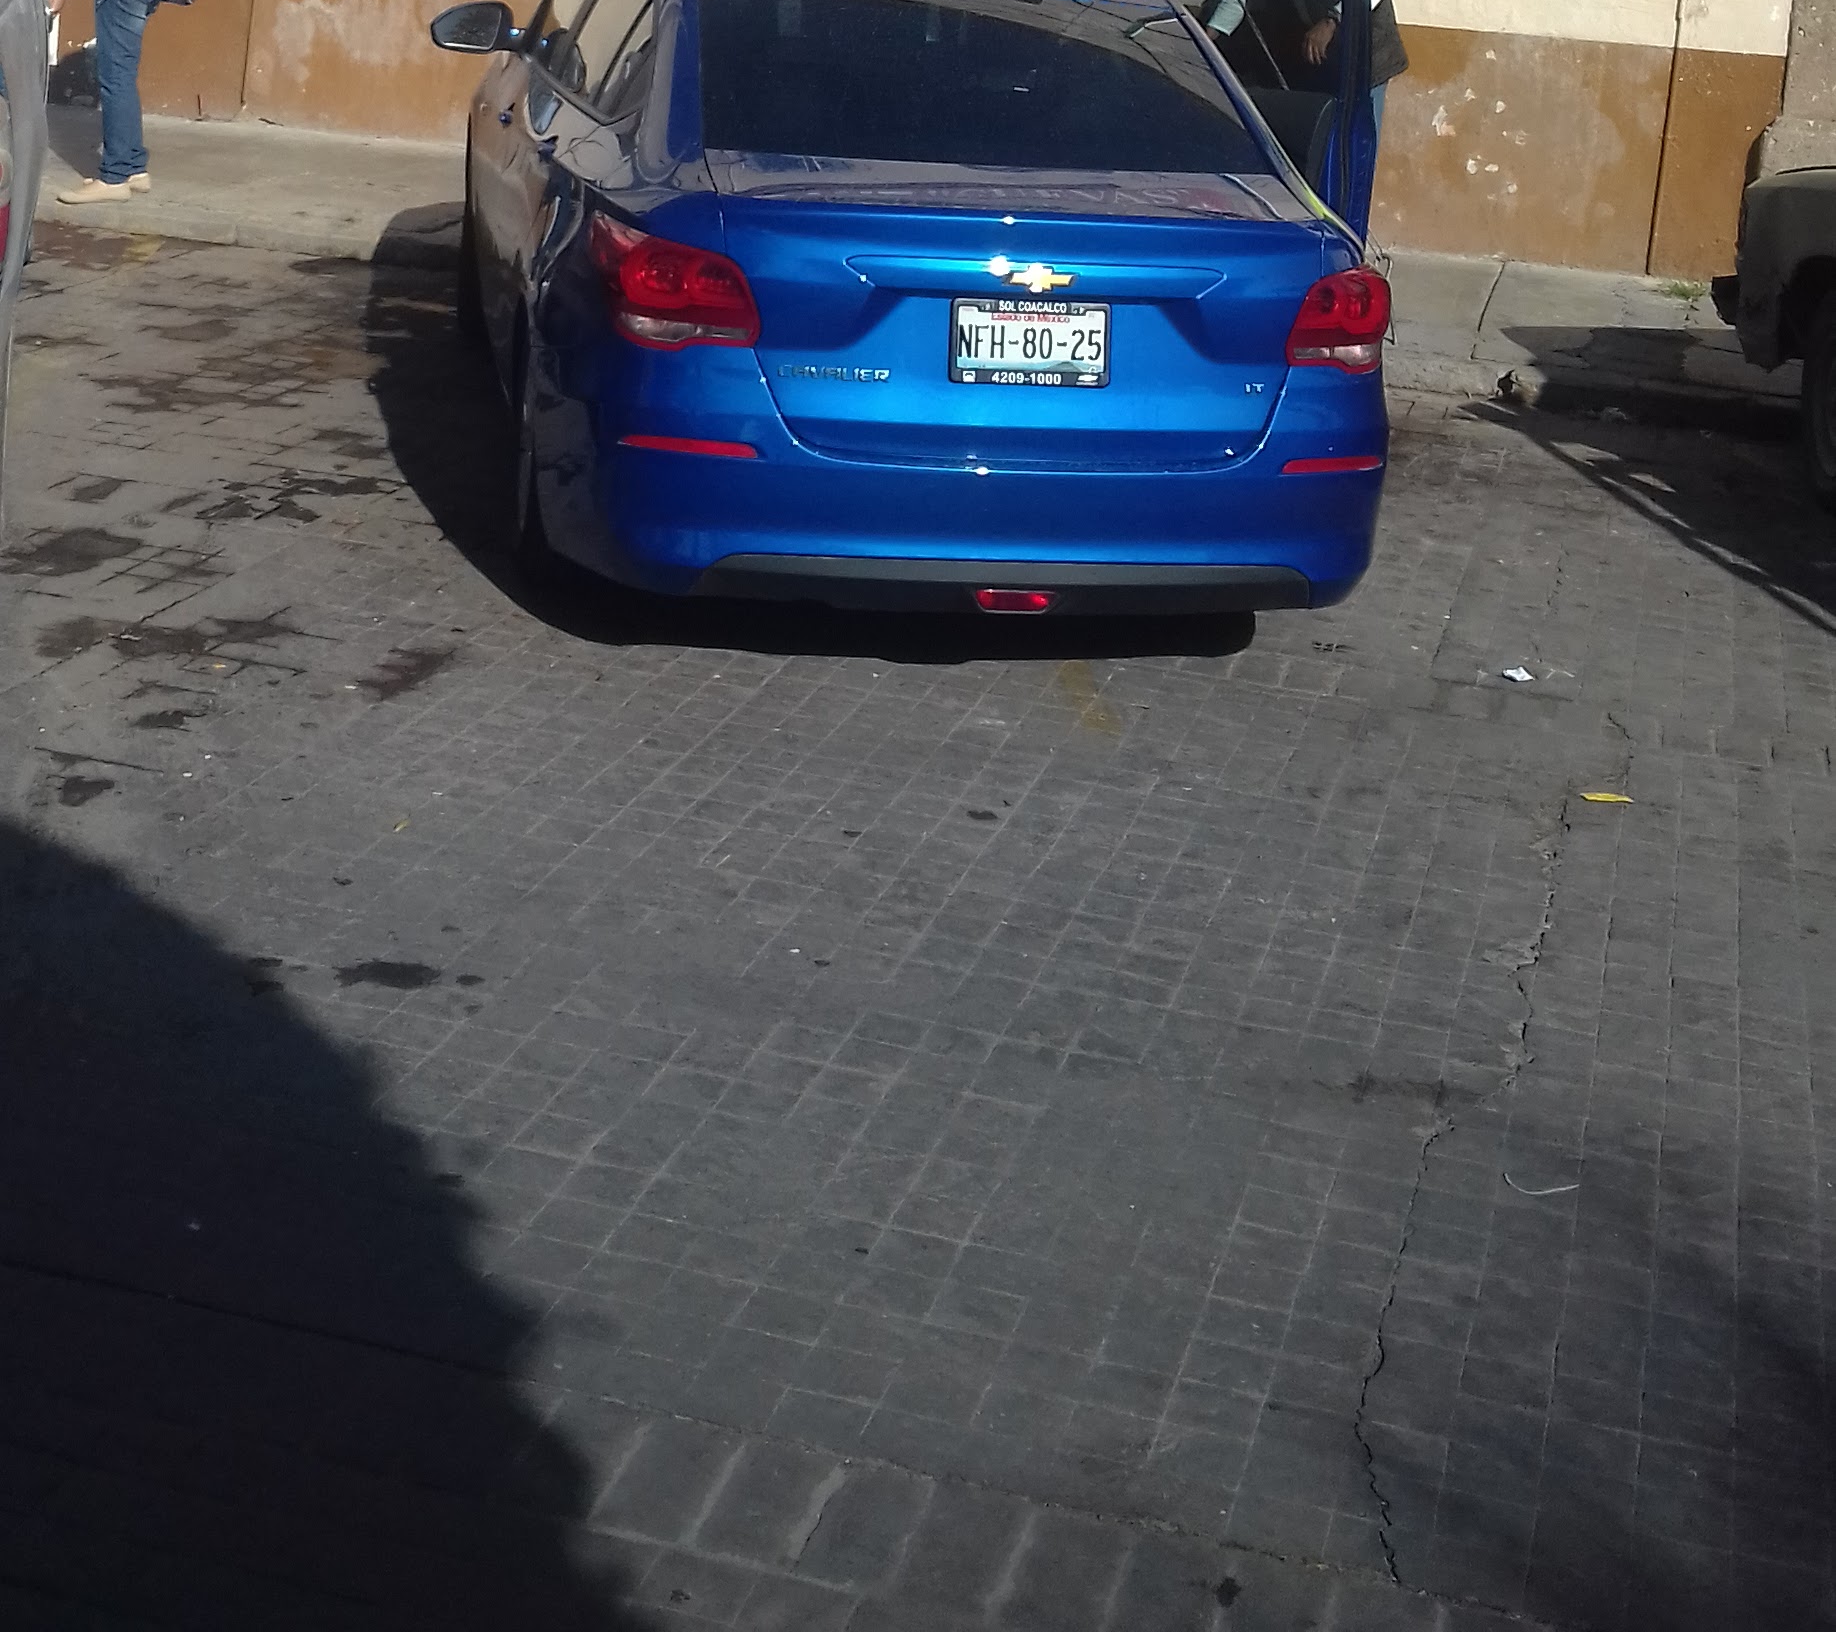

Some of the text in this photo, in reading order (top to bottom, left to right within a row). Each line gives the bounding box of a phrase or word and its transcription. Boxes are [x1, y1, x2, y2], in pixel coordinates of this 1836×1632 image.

[1018, 300, 1067, 314] COACALCO
[958, 324, 1102, 362] NFH-80-25
[777, 364, 891, 383] CAVALIER
[991, 371, 1062, 385] 4209-1000
